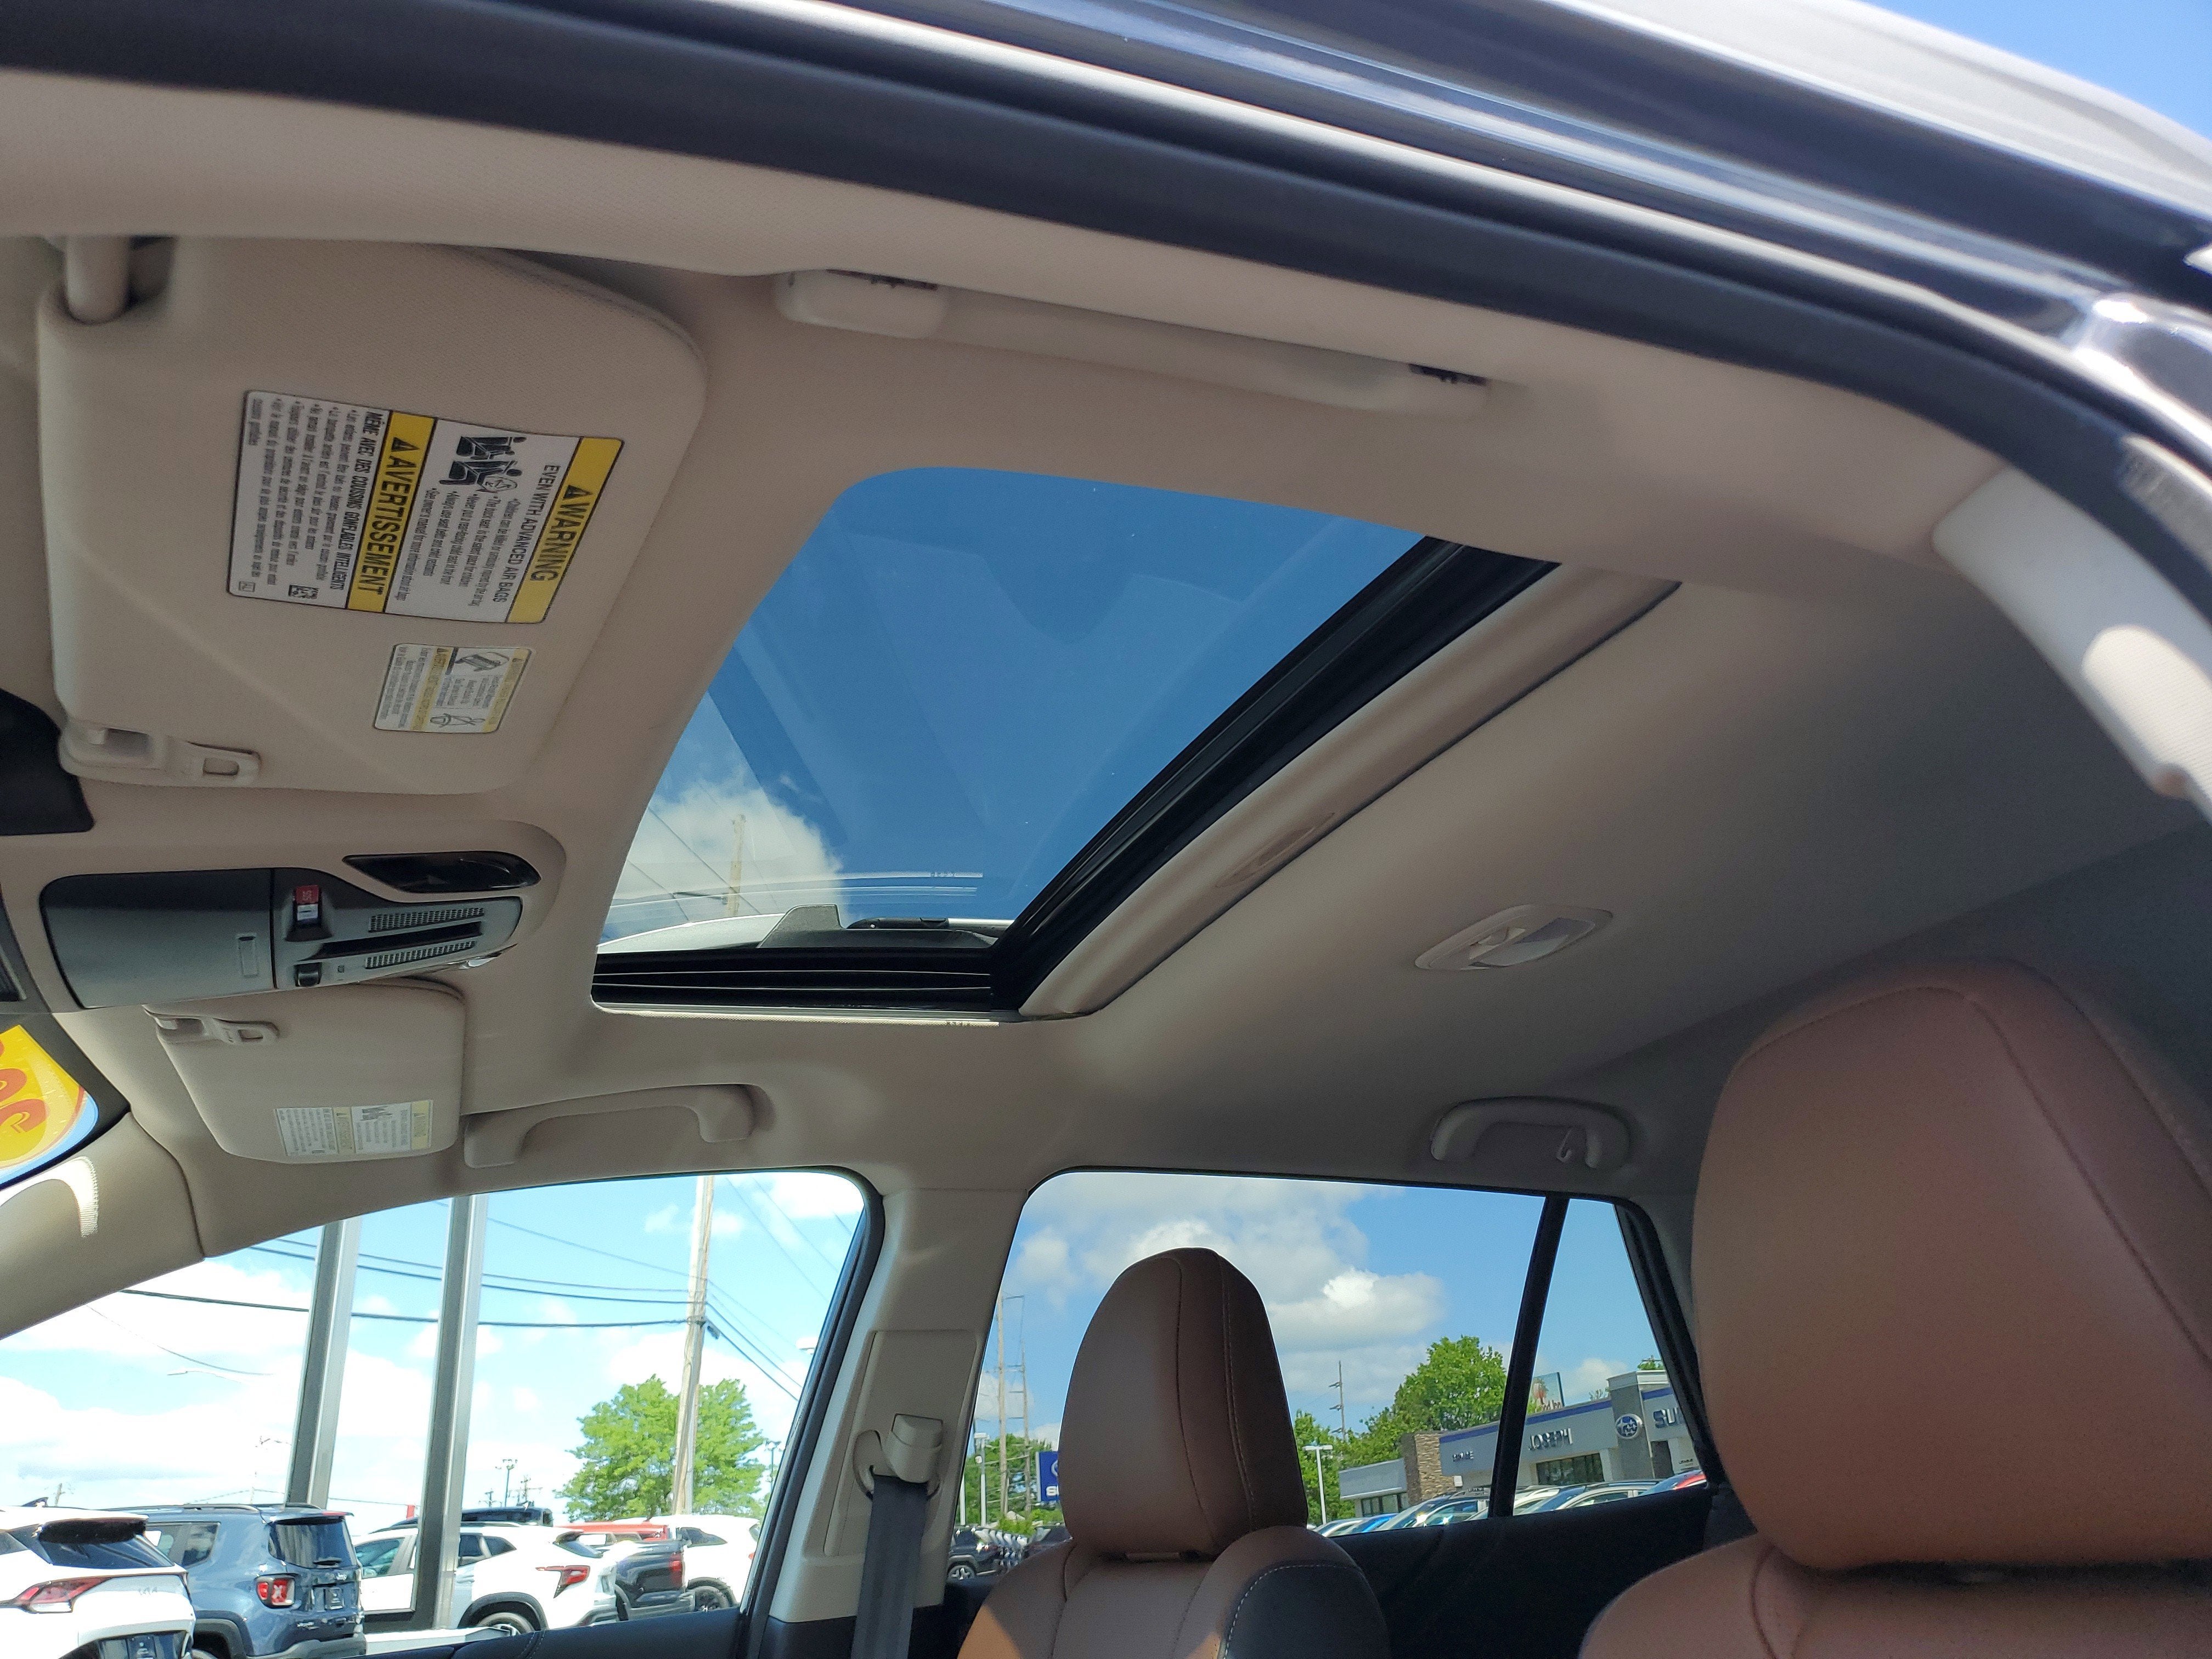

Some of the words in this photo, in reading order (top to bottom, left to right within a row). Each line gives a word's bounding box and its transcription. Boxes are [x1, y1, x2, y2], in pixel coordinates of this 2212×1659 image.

[362, 411, 385, 436] MÊME
[358, 437, 376, 457] AVEC
[354, 458, 373, 473] DES
[536, 465, 561, 491] EVEN
[346, 476, 368, 510] COUSSINS
[526, 493, 549, 516] WITH
[338, 511, 360, 550] GONFLABLES
[359, 457, 415, 594] AVERTISSEMENT
[507, 518, 538, 565] ADVANCED
[531, 503, 589, 581] WARNING
[330, 552, 351, 590] INTELLIGENTS
[501, 566, 519, 580] AIR
[492, 582, 514, 602] BAGS
[1528, 1427, 1573, 1451] JOSEPH
